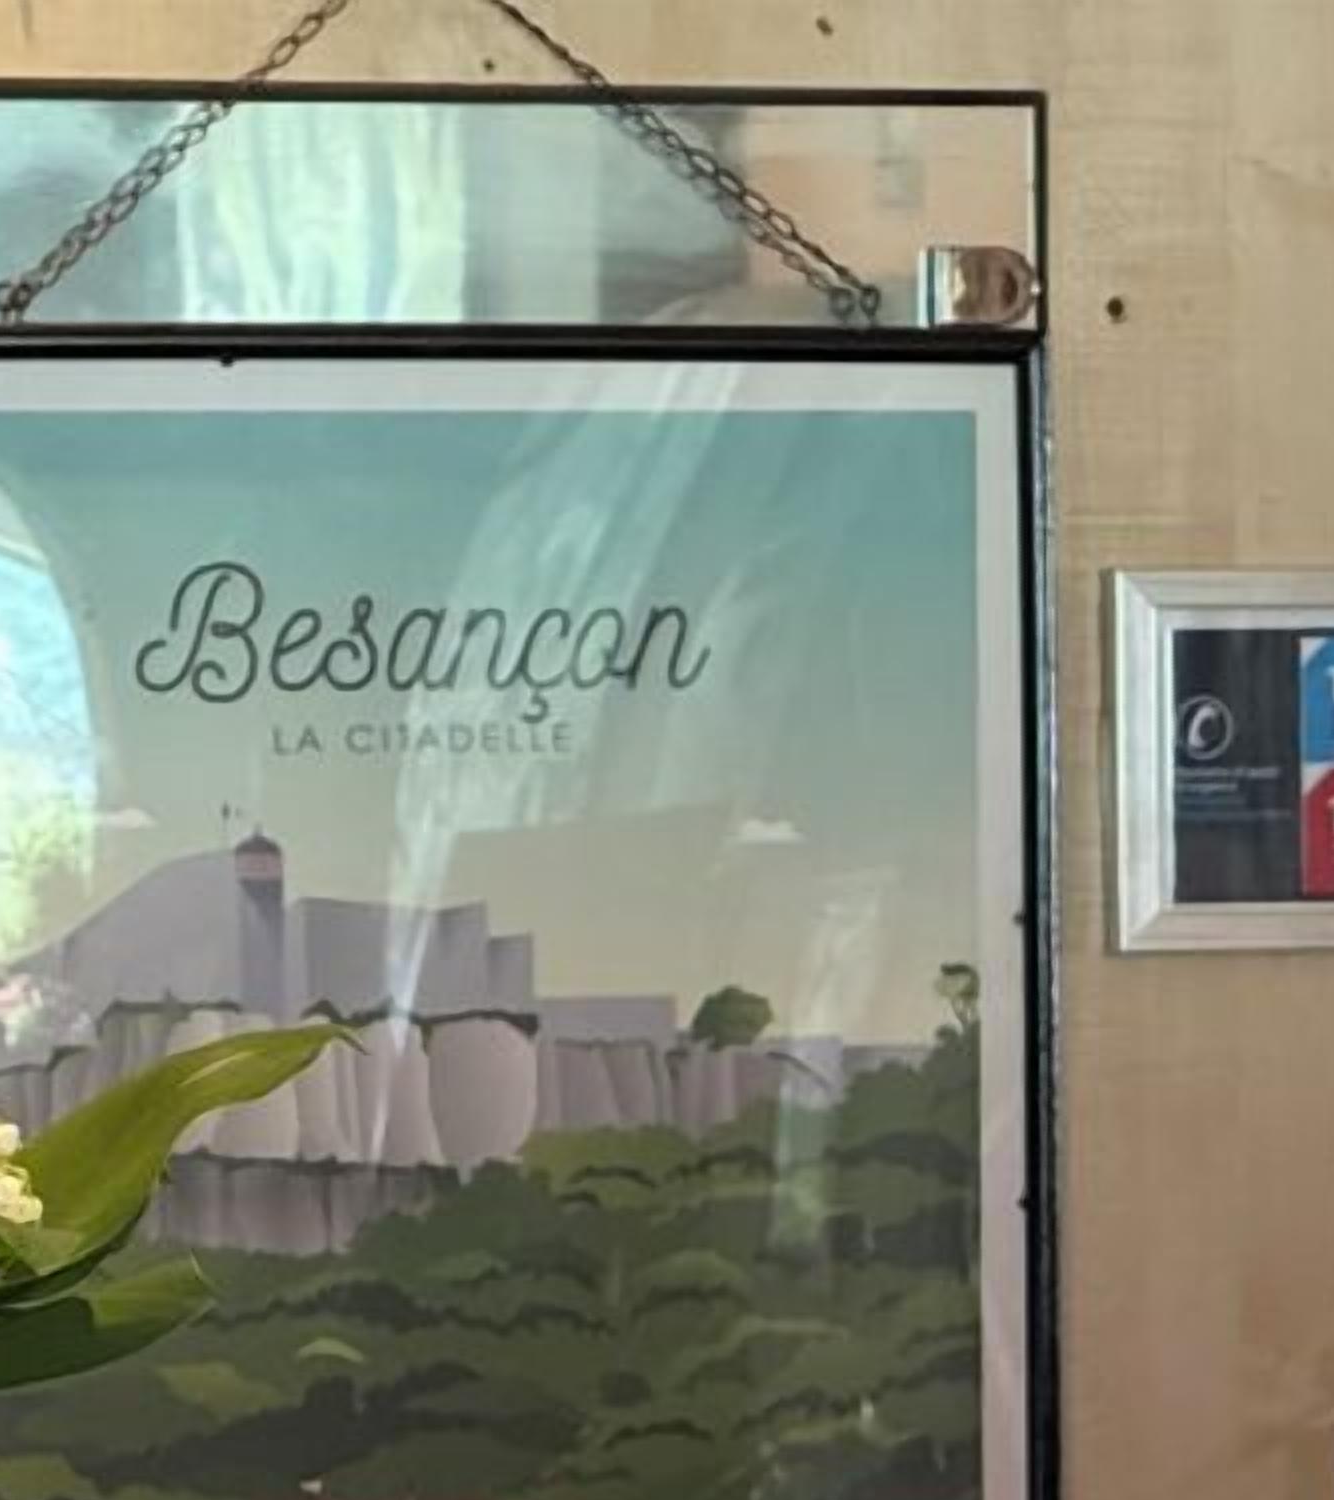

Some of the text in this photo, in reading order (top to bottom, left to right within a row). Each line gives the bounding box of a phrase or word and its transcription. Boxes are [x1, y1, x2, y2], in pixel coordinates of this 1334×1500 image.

[135, 561, 711, 723] Besançon
[272, 721, 572, 757] LA CITADELLE
